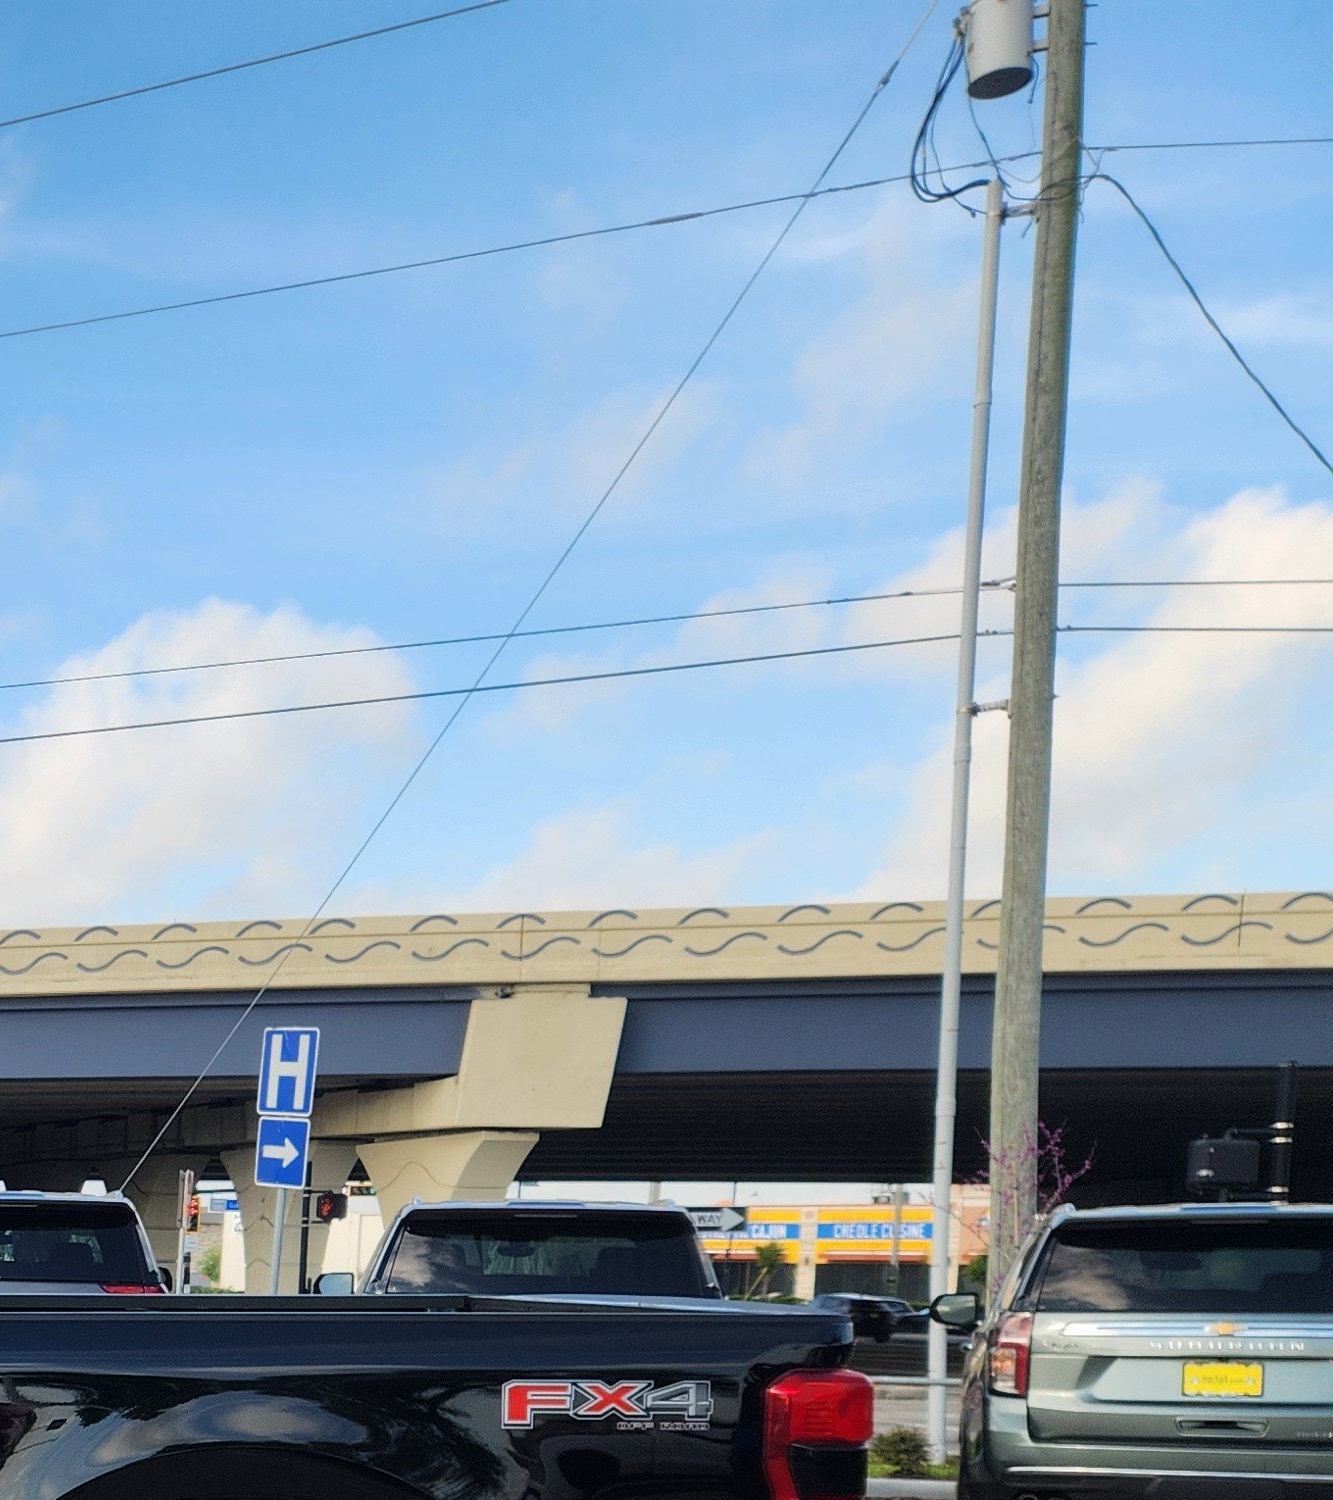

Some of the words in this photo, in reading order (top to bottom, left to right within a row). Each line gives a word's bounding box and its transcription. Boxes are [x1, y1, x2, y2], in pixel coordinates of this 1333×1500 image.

[268, 1033, 310, 1110] H
[697, 1213, 722, 1224] WAY
[750, 1222, 786, 1239] CAJUN
[834, 1223, 879, 1239] CREOLE
[882, 1223, 925, 1239] CUSINE
[1149, 1341, 1305, 1351] SUBURBAN
[502, 1379, 714, 1429] FX4
[617, 1421, 654, 1431] OFF
[660, 1421, 710, 1431] ROAD
